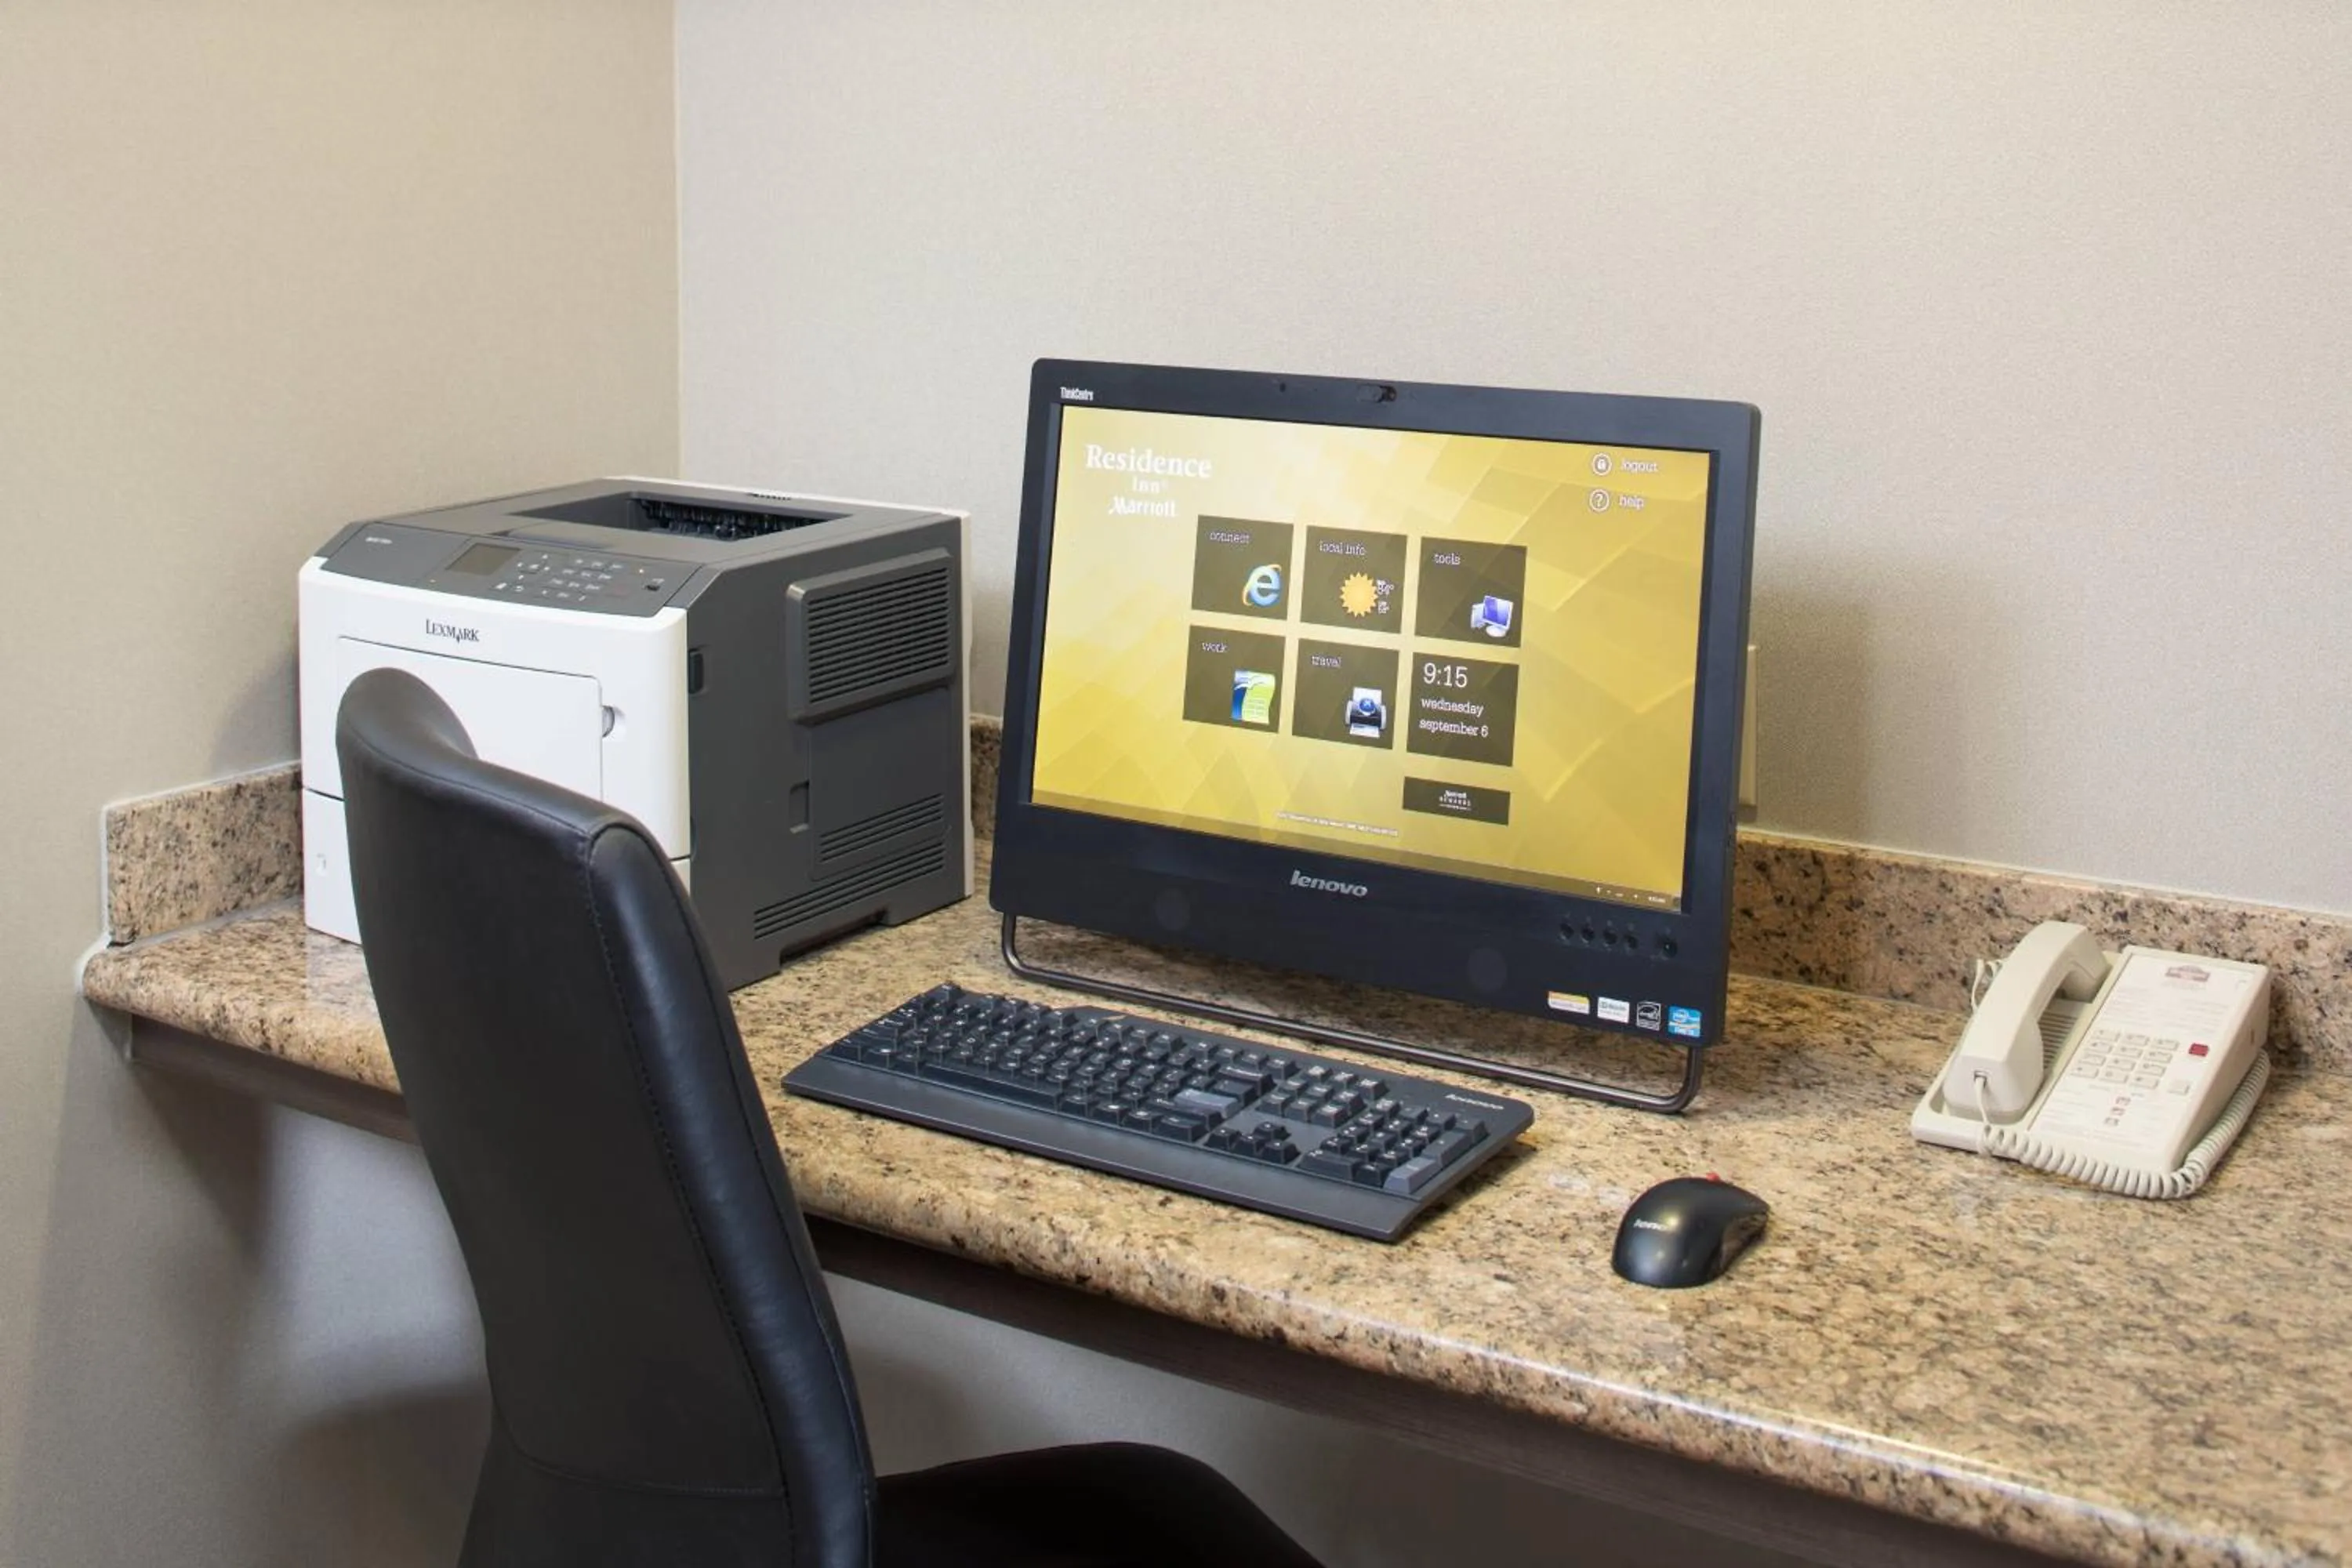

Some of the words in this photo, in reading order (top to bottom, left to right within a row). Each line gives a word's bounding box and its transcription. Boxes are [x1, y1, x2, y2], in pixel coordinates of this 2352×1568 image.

[1086, 443, 1212, 478] Residence
[1621, 459, 1658, 473] logout
[1108, 495, 1177, 517] Marriott
[1619, 495, 1644, 510] help
[1209, 531, 1250, 545] connect
[1319, 539, 1343, 555] local
[1345, 543, 1367, 557] info
[1433, 552, 1461, 565] tools
[426, 619, 481, 644] LEXMARK
[1202, 641, 1229, 654] work
[1312, 655, 1342, 669] travel
[1423, 662, 1468, 688] 9:15
[1420, 697, 1485, 718] wednesday
[1418, 719, 1479, 736] september
[1481, 724, 1489, 738] 6
[1290, 869, 1368, 897] lenovo
